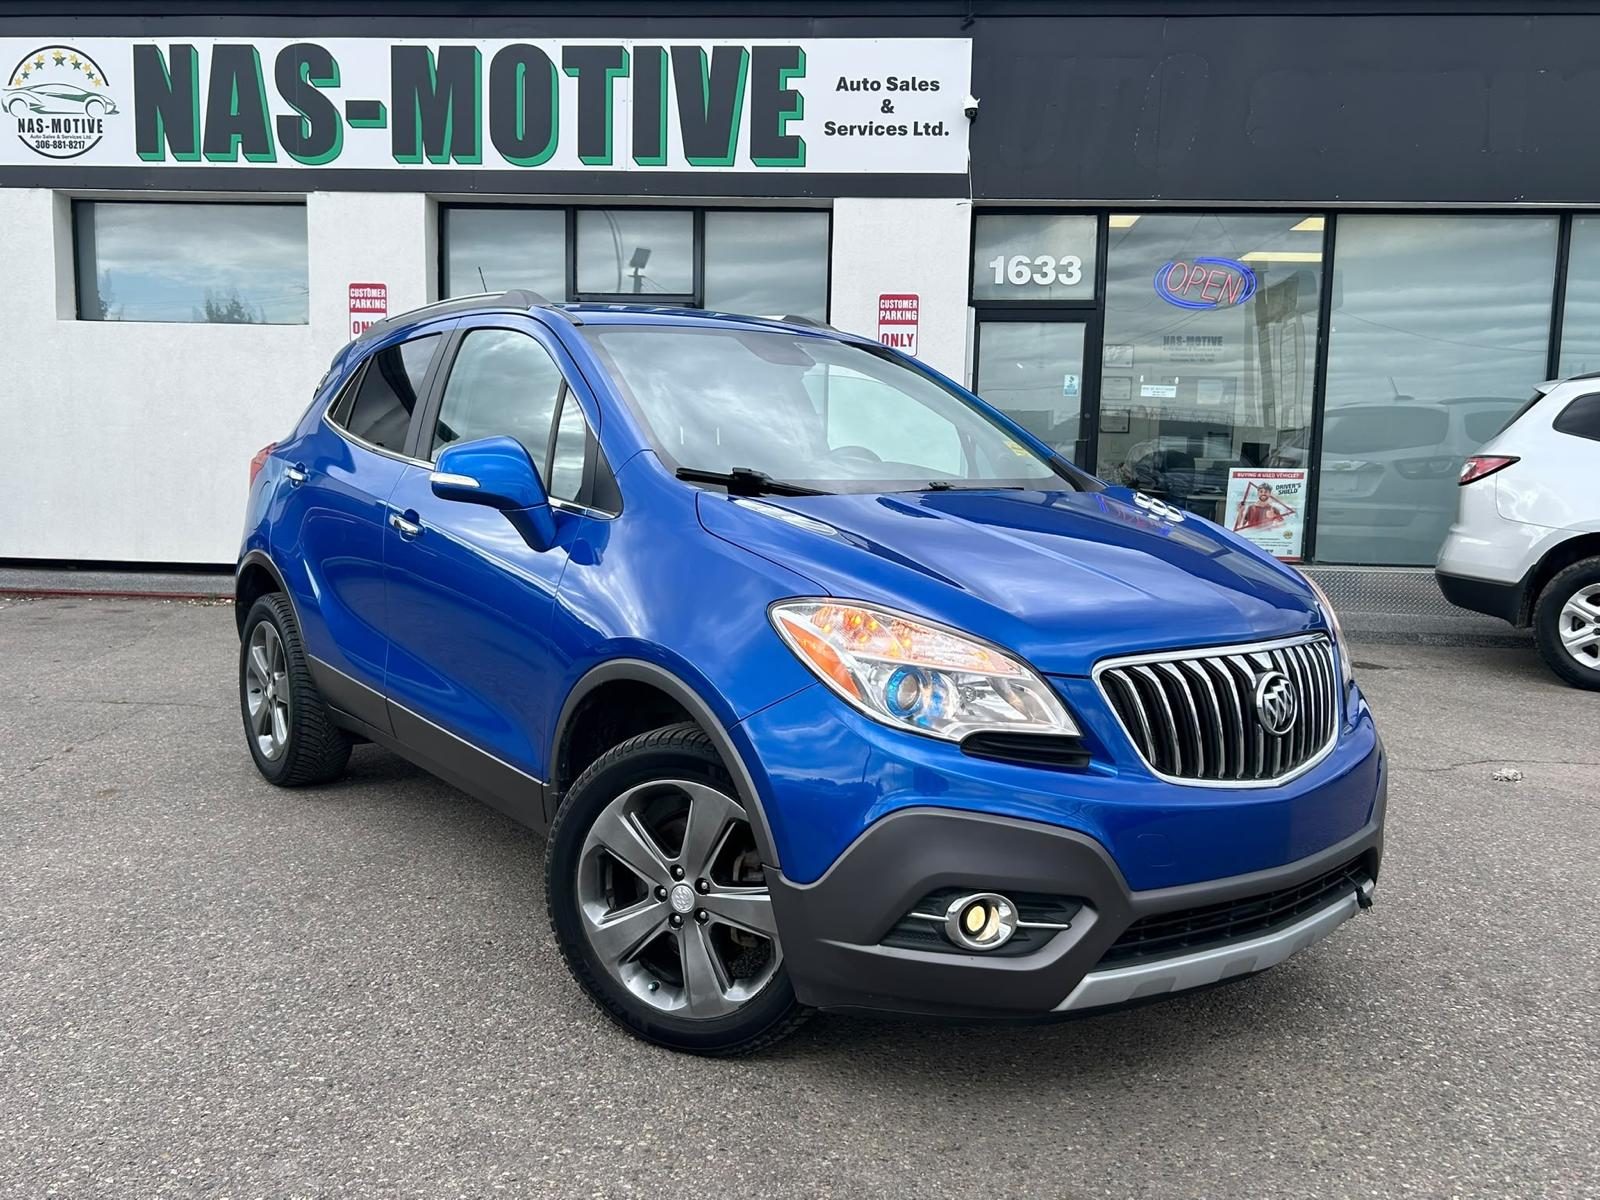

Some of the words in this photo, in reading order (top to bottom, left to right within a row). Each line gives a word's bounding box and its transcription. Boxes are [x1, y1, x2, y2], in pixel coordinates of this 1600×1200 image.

[835, 76, 882, 92] Auto
[885, 76, 941, 92] Sales
[132, 42, 807, 169] NAS-MOTIVE
[880, 98, 895, 114] &
[18, 118, 103, 133] NAS-MOTIVE
[823, 120, 908, 137] Services
[913, 121, 950, 137] Ltd.
[35, 140, 86, 149] 306-881-8217
[989, 254, 1082, 286] 1633
[1167, 262, 1243, 304] OPEN
[350, 288, 386, 297] CUSTOMER
[350, 299, 386, 308] PARKING
[880, 299, 918, 309] CUSTOMER
[880, 310, 918, 321] PARKING
[353, 321, 374, 334] ON
[881, 333, 914, 347] ONLY
[1275, 482, 1302, 491] DRIVER'S
